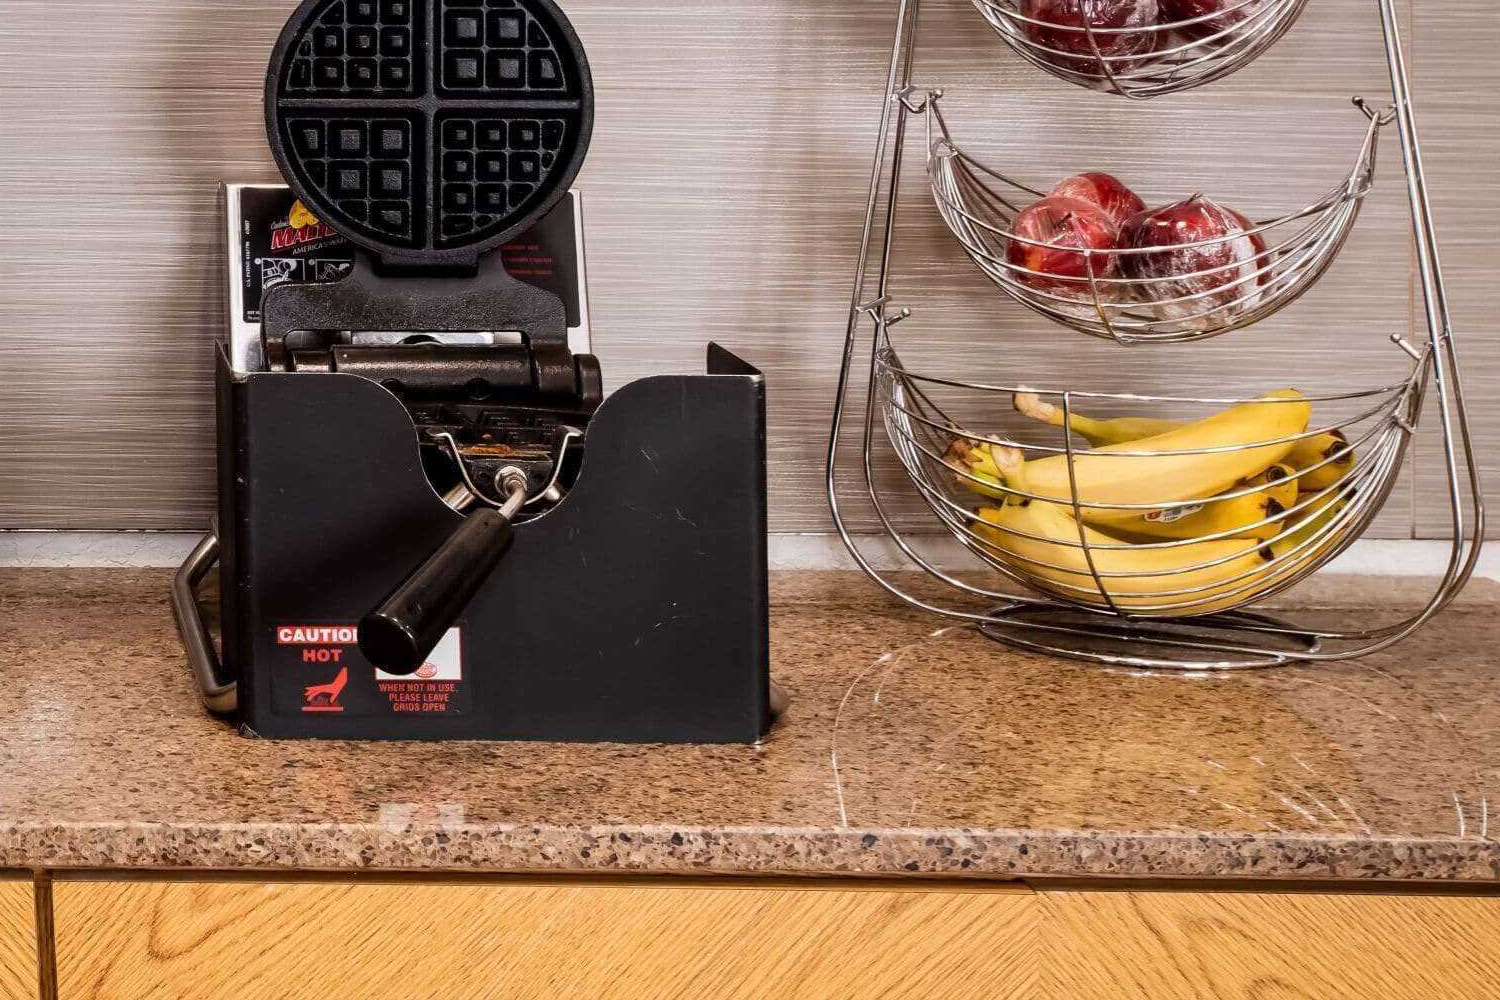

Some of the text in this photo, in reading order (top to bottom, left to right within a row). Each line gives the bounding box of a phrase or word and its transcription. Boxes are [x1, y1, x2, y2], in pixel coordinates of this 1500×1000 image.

[279, 628, 358, 642] CAUTIO
[303, 649, 342, 662] HOT
[379, 683, 405, 692] WHEN
[407, 683, 424, 692] NOT
[427, 683, 436, 692] IN
[389, 693, 450, 701] PLEASE LEAVE
[393, 702, 445, 712] GRIDS OPEN
